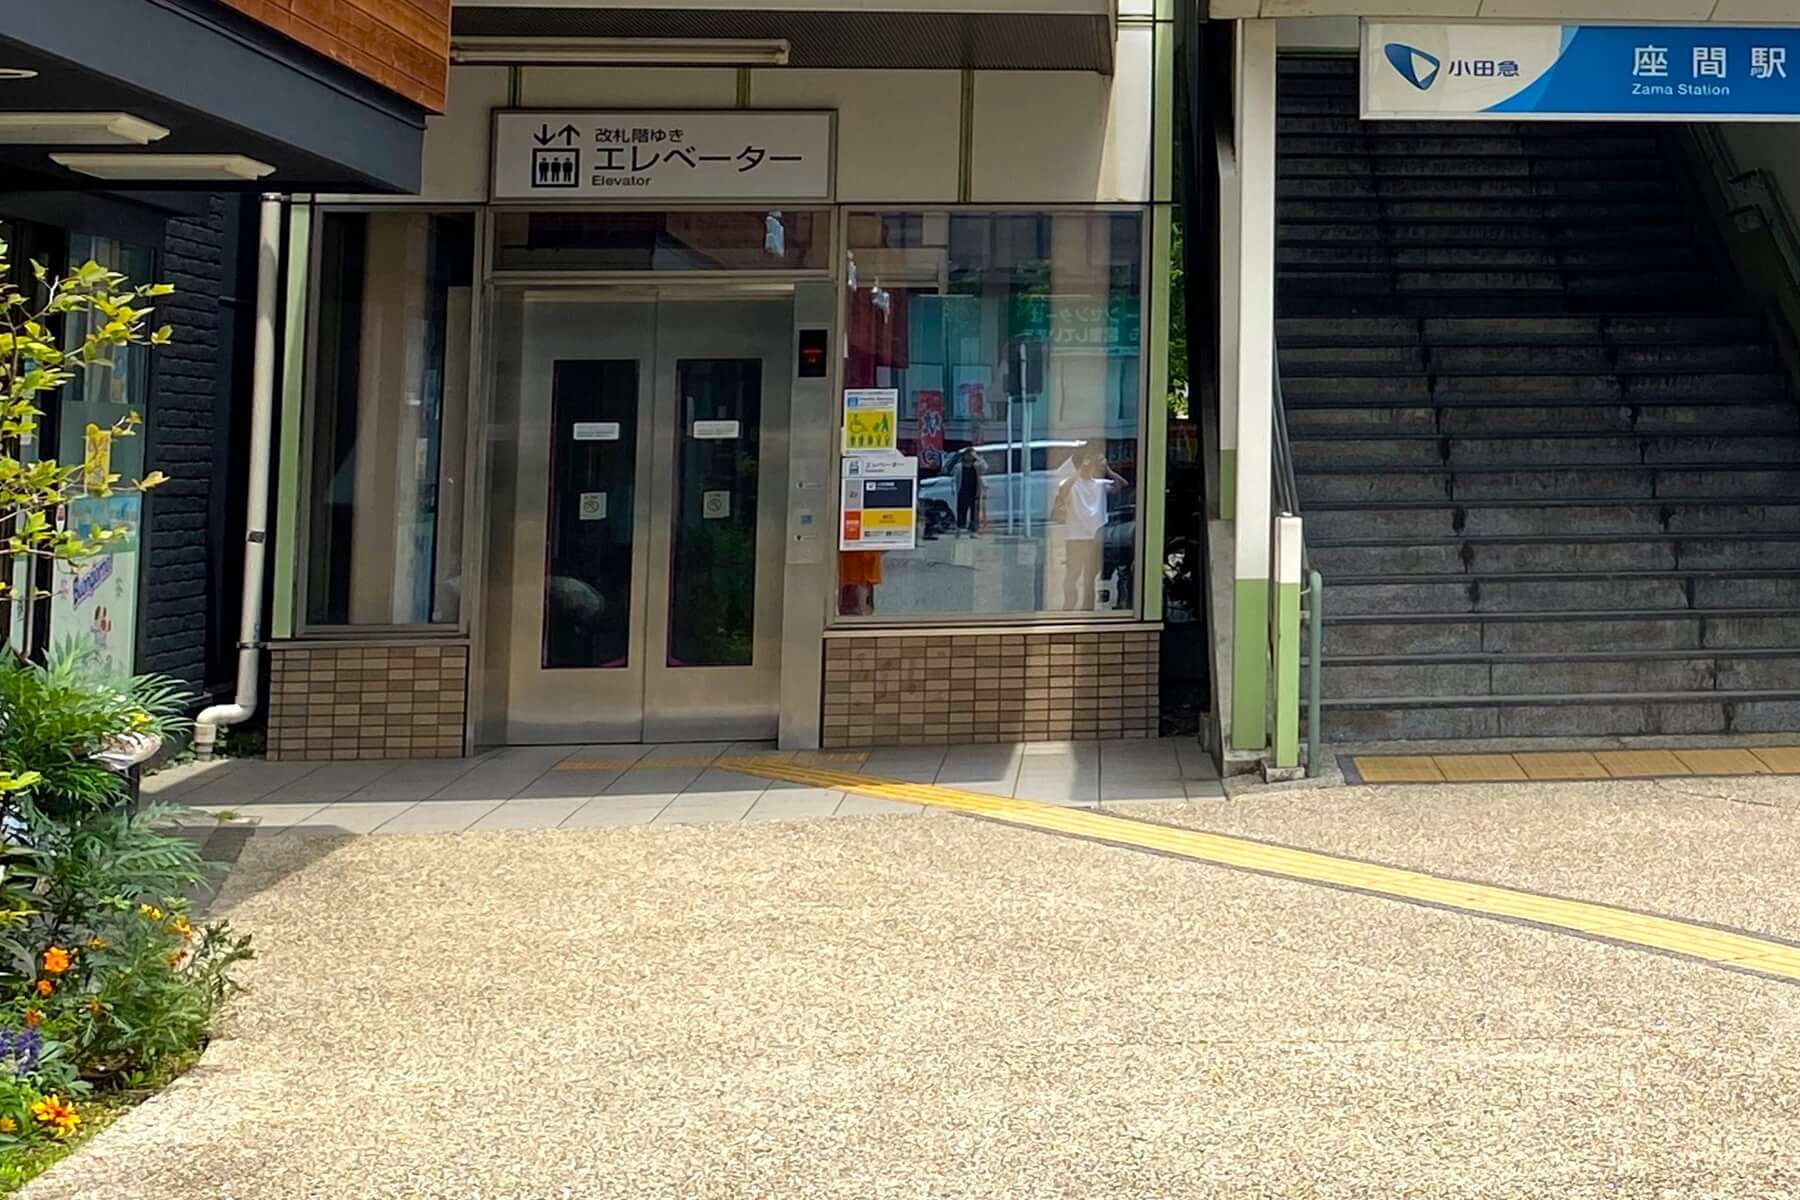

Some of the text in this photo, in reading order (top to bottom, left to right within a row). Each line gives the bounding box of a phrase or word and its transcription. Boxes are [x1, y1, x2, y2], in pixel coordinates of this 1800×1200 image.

[1448, 45, 1787, 80] 小田急 座間駅
[1632, 83, 1731, 97] Zama Station
[594, 127, 685, 143] 改札階ゆき
[594, 145, 802, 173] エレベーター
[592, 175, 652, 187] Elevator
